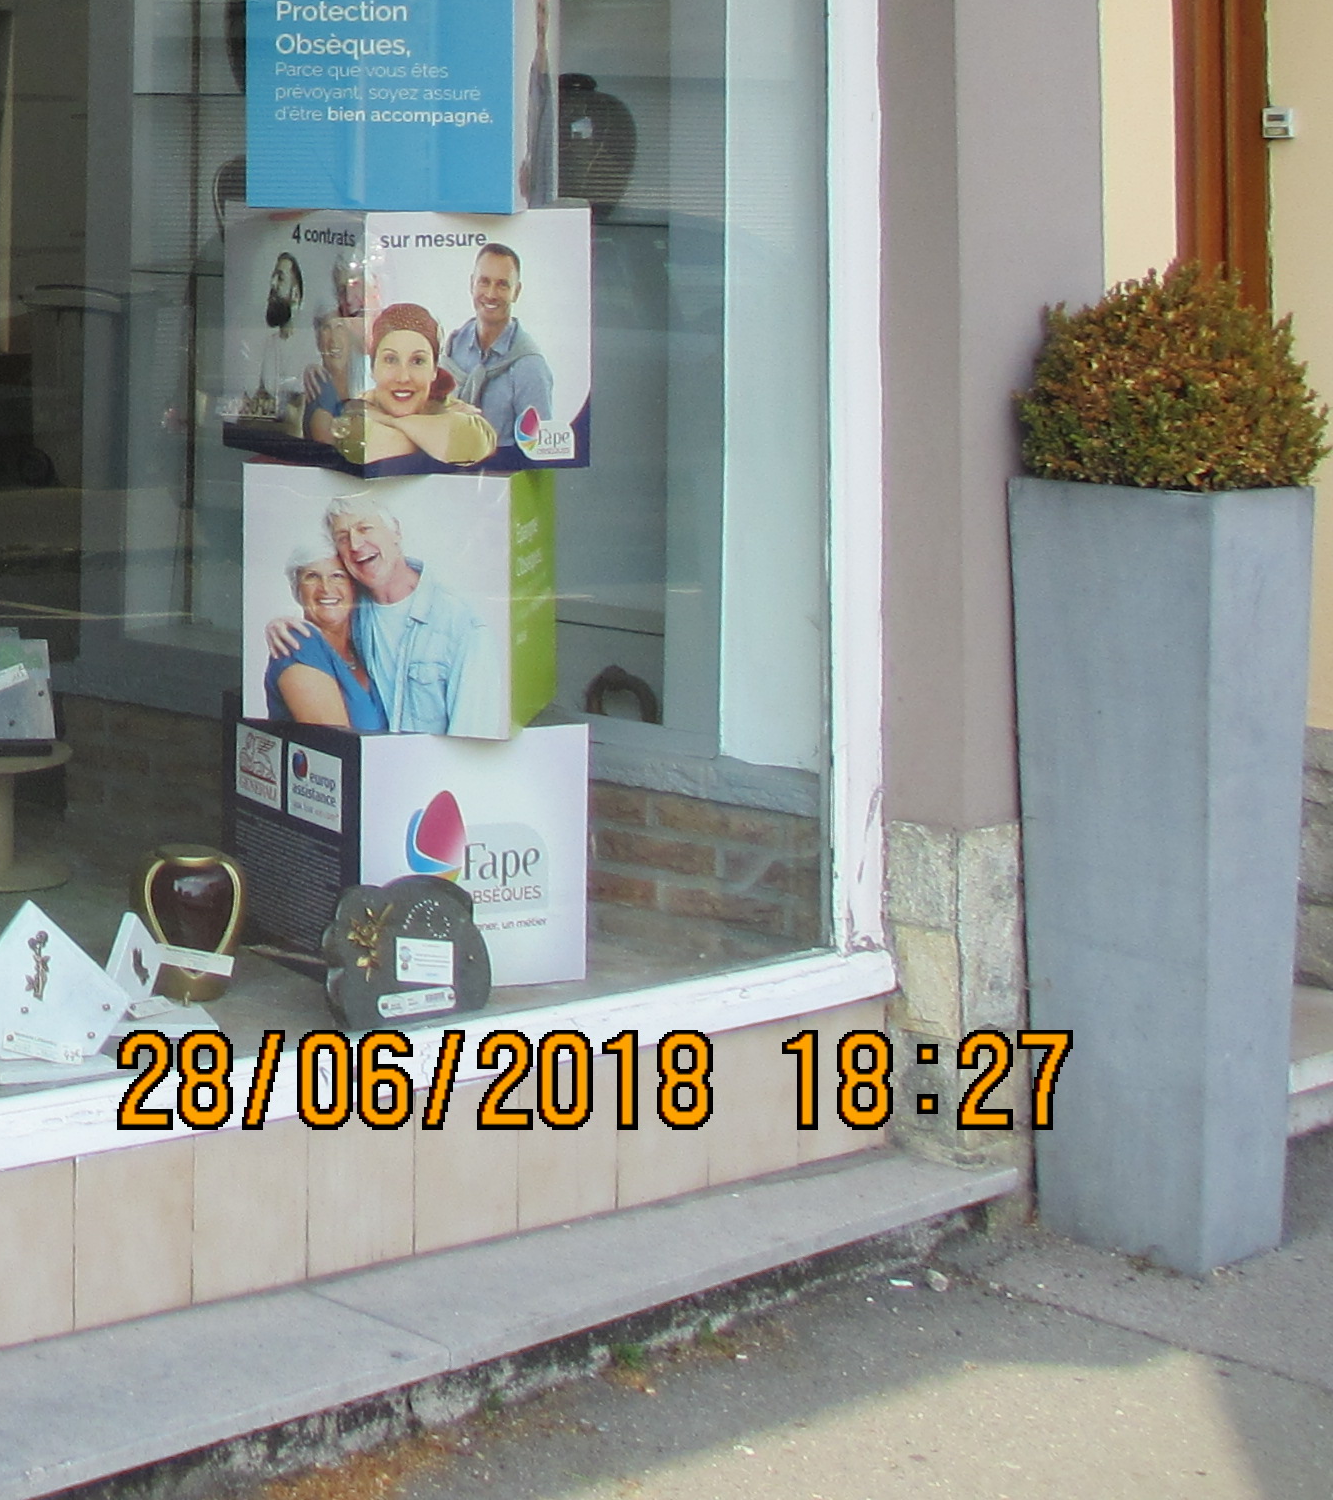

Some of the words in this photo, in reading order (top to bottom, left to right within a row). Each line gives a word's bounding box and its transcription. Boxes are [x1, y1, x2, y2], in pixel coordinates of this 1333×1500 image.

[276, 0, 408, 23] Protection
[275, 33, 412, 61] Obsèques,
[275, 61, 324, 79] Parce
[327, 64, 361, 82] que
[364, 64, 406, 78] vous
[411, 61, 449, 79] êtes
[275, 84, 364, 102] prévoyant,
[369, 85, 418, 104] soyez
[422, 84, 481, 101] assuré
[275, 106, 323, 122] d'être
[327, 106, 366, 122] bien
[370, 108, 494, 127] accompagné.
[292, 223, 301, 243] 4
[304, 226, 356, 248] contrats
[379, 232, 412, 249] sur
[414, 230, 488, 248] mesure
[462, 843, 540, 887] Fape
[472, 884, 543, 905] BSÈQUES
